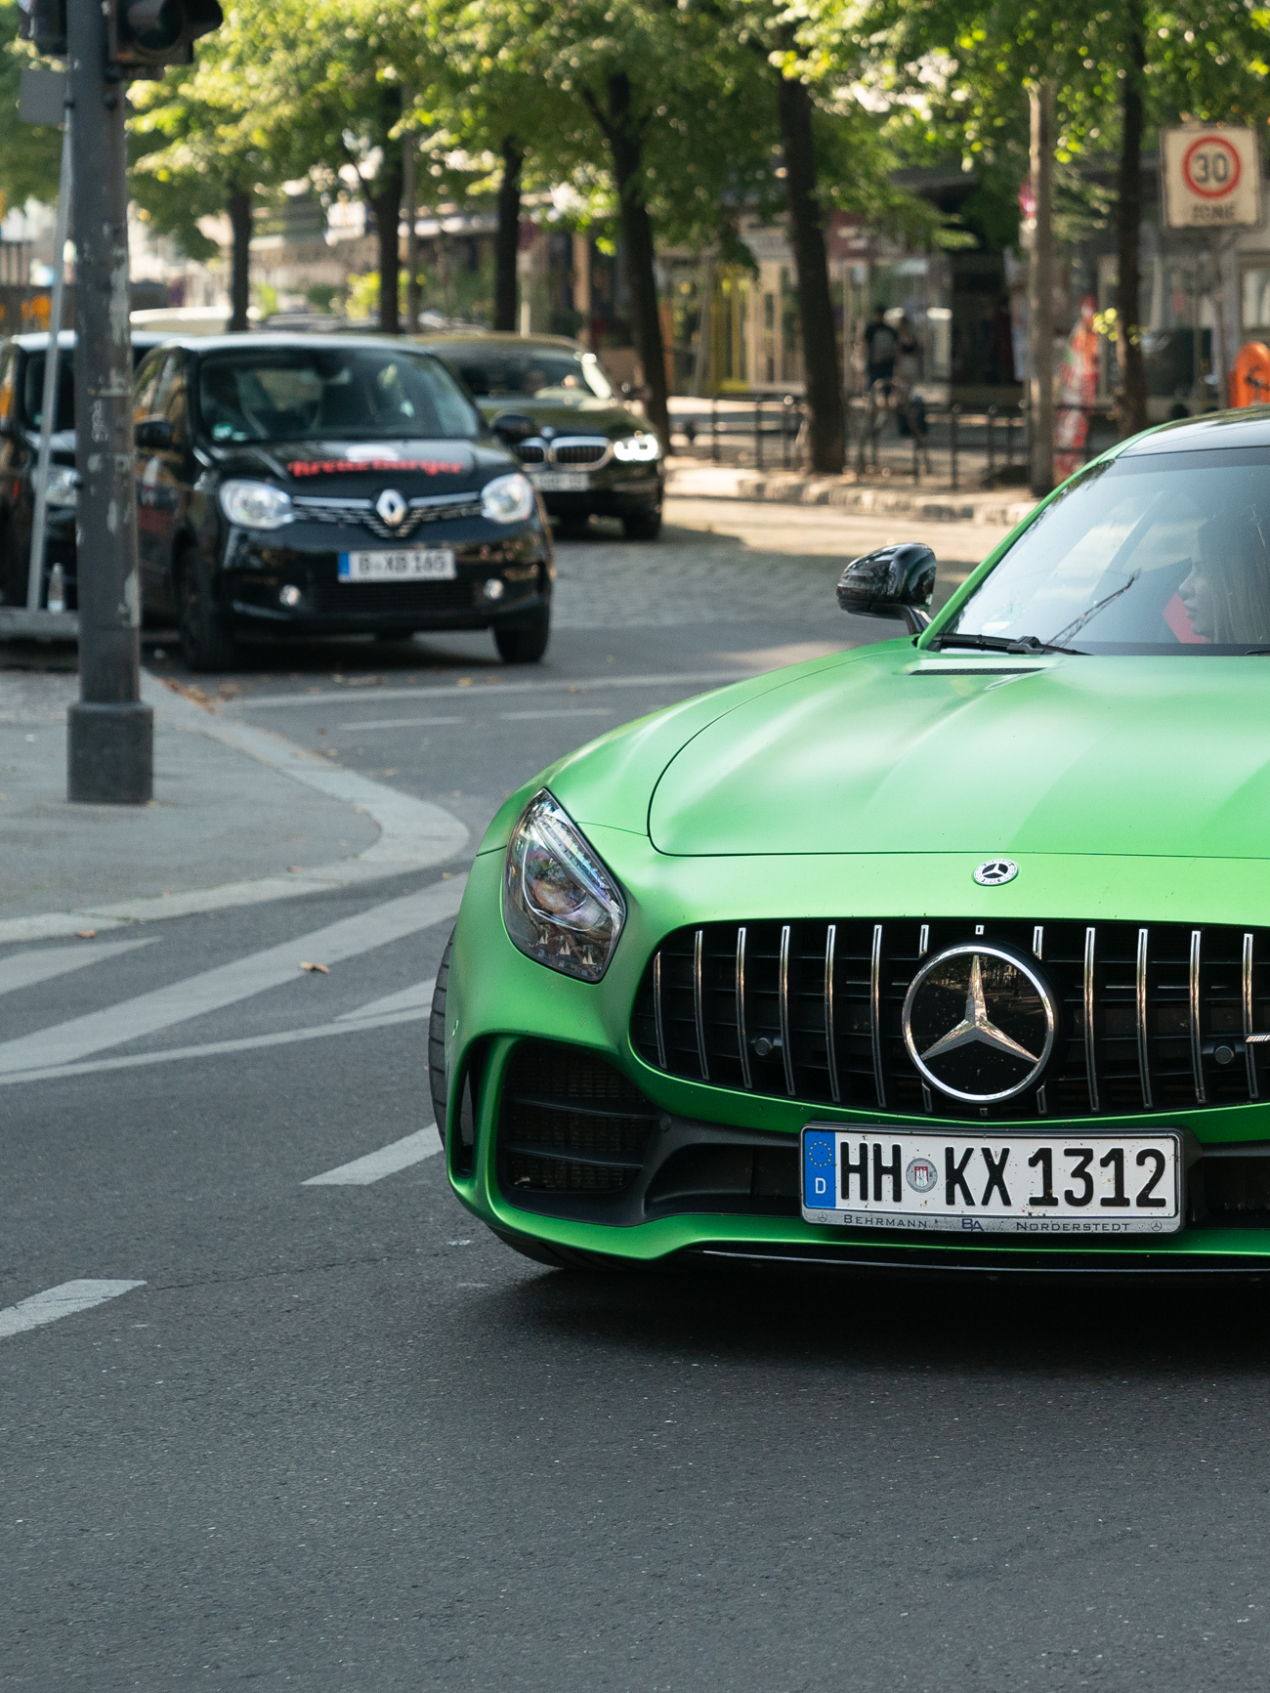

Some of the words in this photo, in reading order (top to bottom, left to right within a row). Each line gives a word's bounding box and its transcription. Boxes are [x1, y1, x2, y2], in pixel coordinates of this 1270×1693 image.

[1194, 152, 1230, 184] 30
[1192, 203, 1236, 220] ZONE
[814, 1177, 827, 1195] D
[840, 1141, 902, 1203] HH
[944, 1146, 1012, 1207] KX
[1027, 1147, 1167, 1208] 1312
